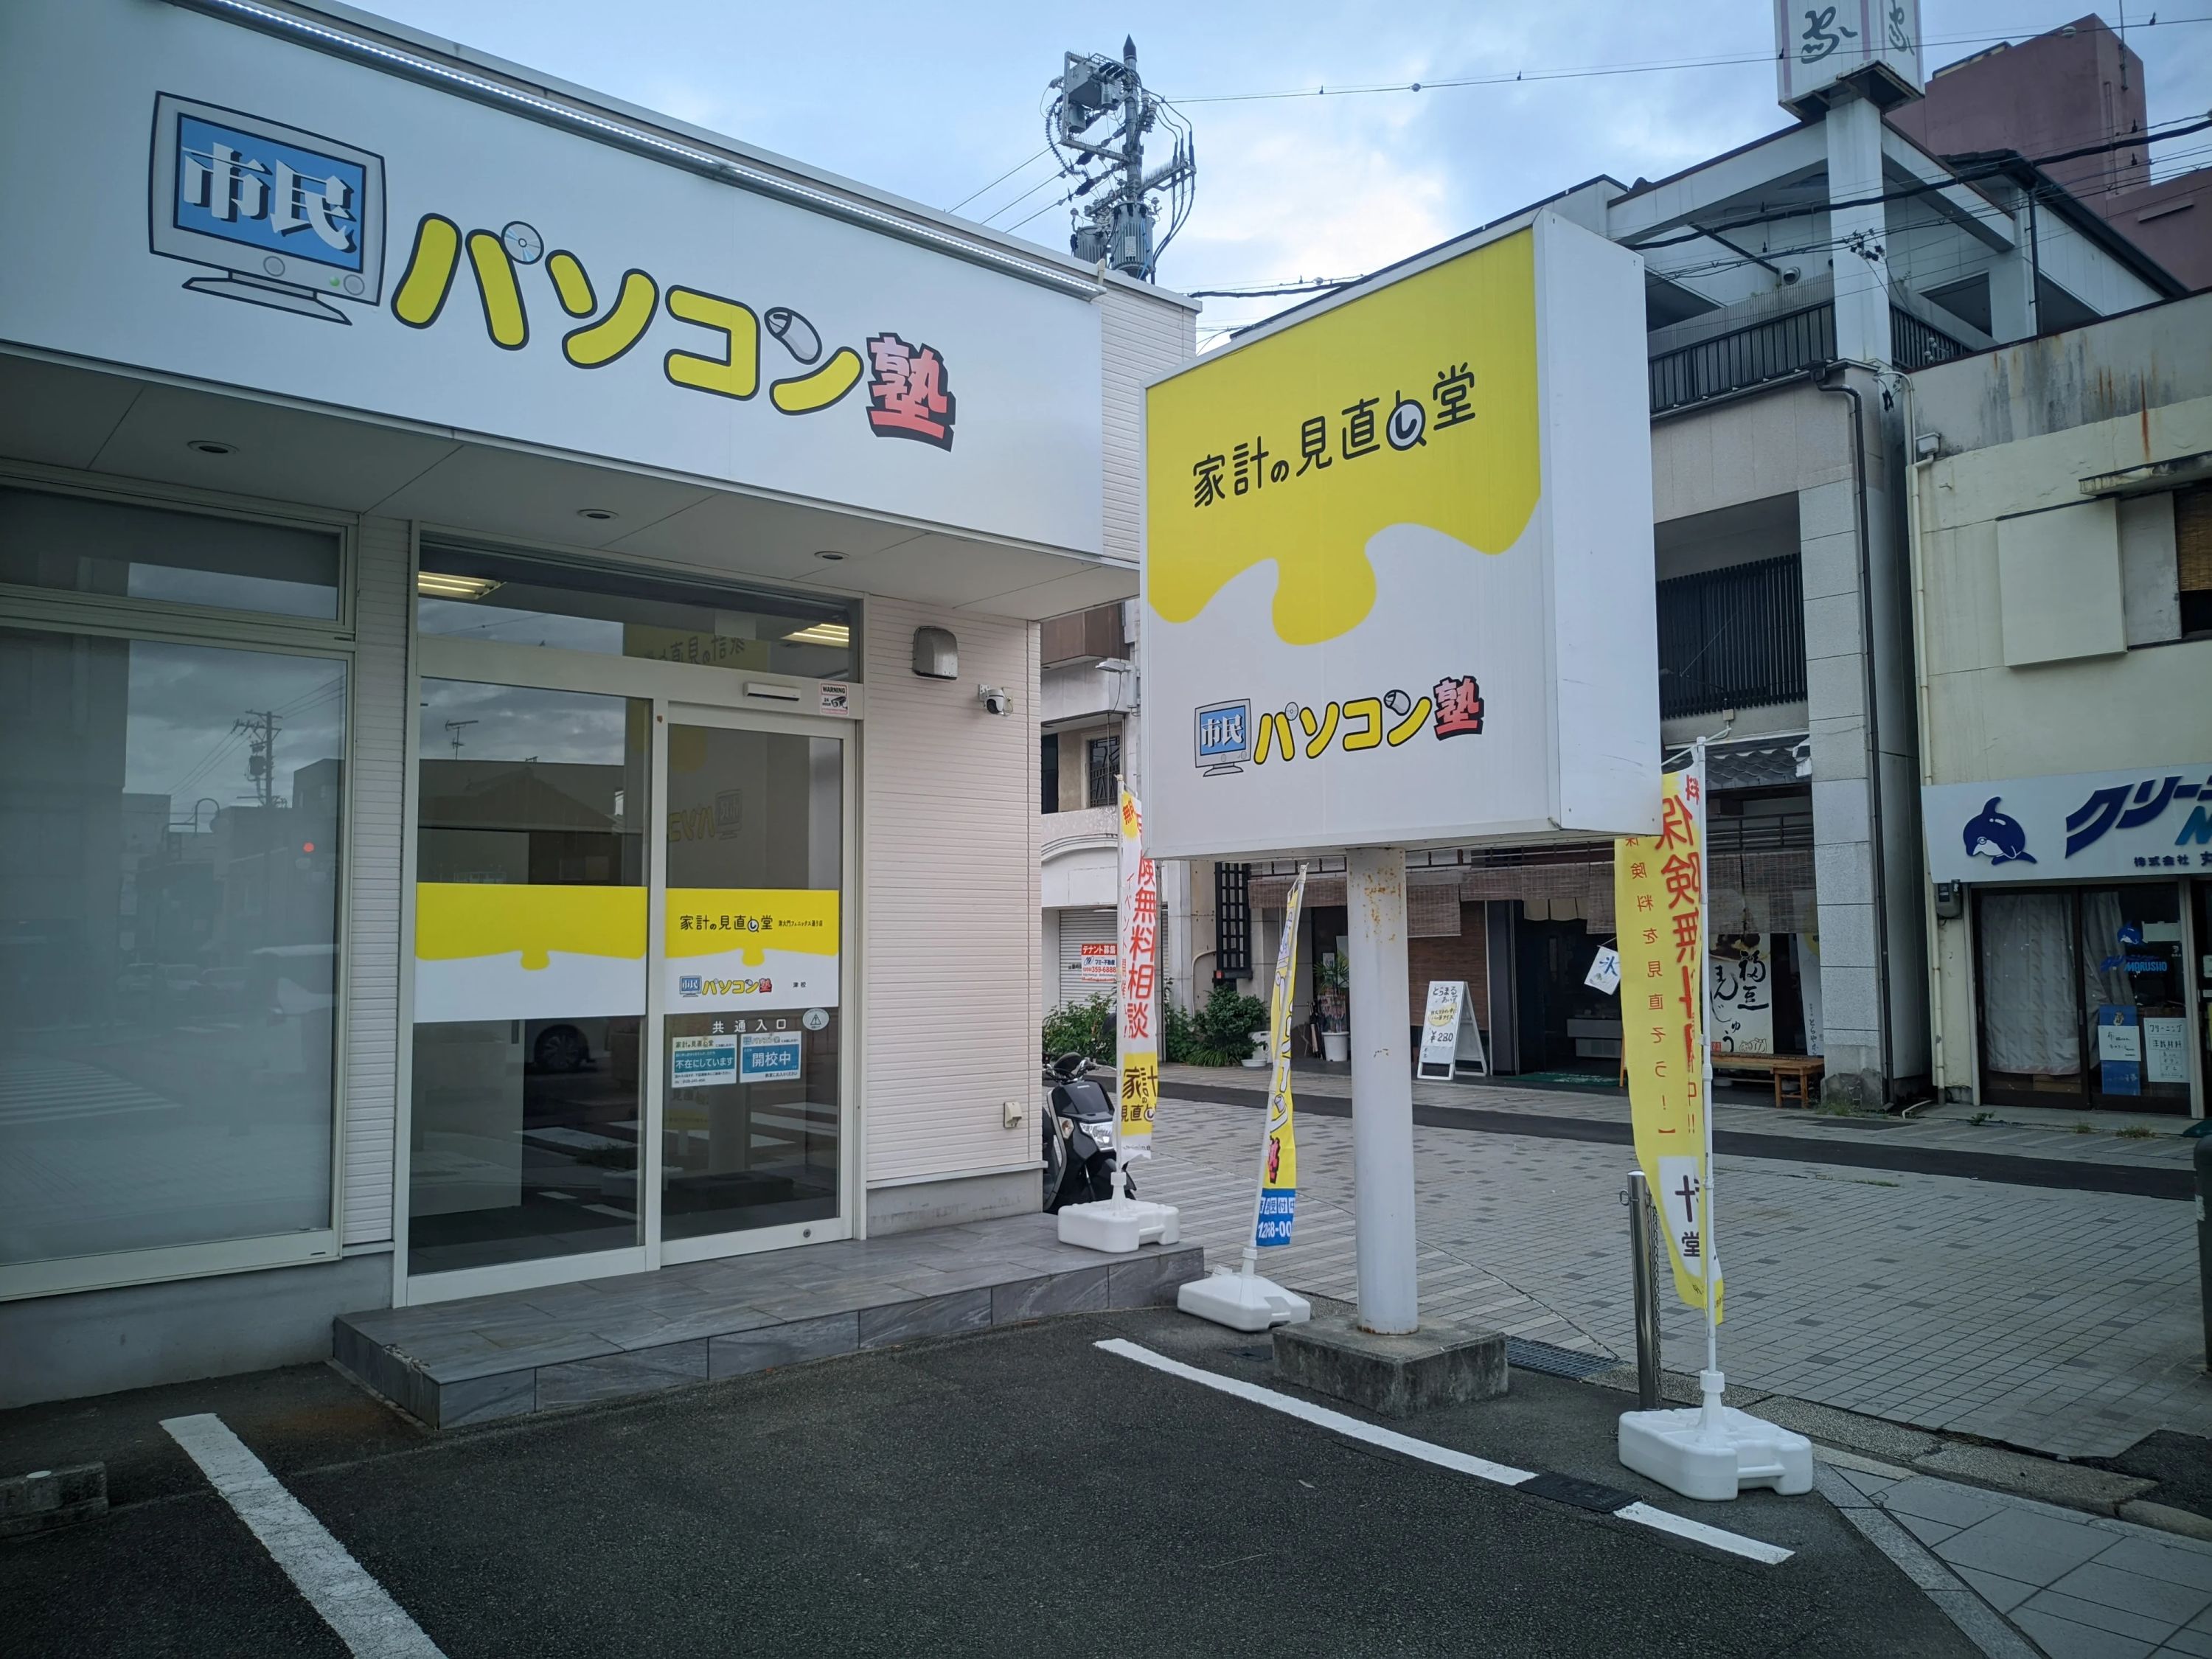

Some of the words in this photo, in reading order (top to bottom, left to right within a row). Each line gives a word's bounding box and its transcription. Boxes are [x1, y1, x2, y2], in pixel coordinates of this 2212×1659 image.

[1193, 362, 1476, 508] 家計の見直し堂
[2134, 855, 2189, 867] 株式会社
[680, 914, 773, 933] 家計の見直し堂
[1128, 814, 1156, 1038] 険無料相談
[1082, 945, 1116, 954] テナント募集
[712, 1019, 787, 1033] 共通入口
[675, 1057, 734, 1069] 不在にしています
[752, 1051, 791, 1068] 開校中
